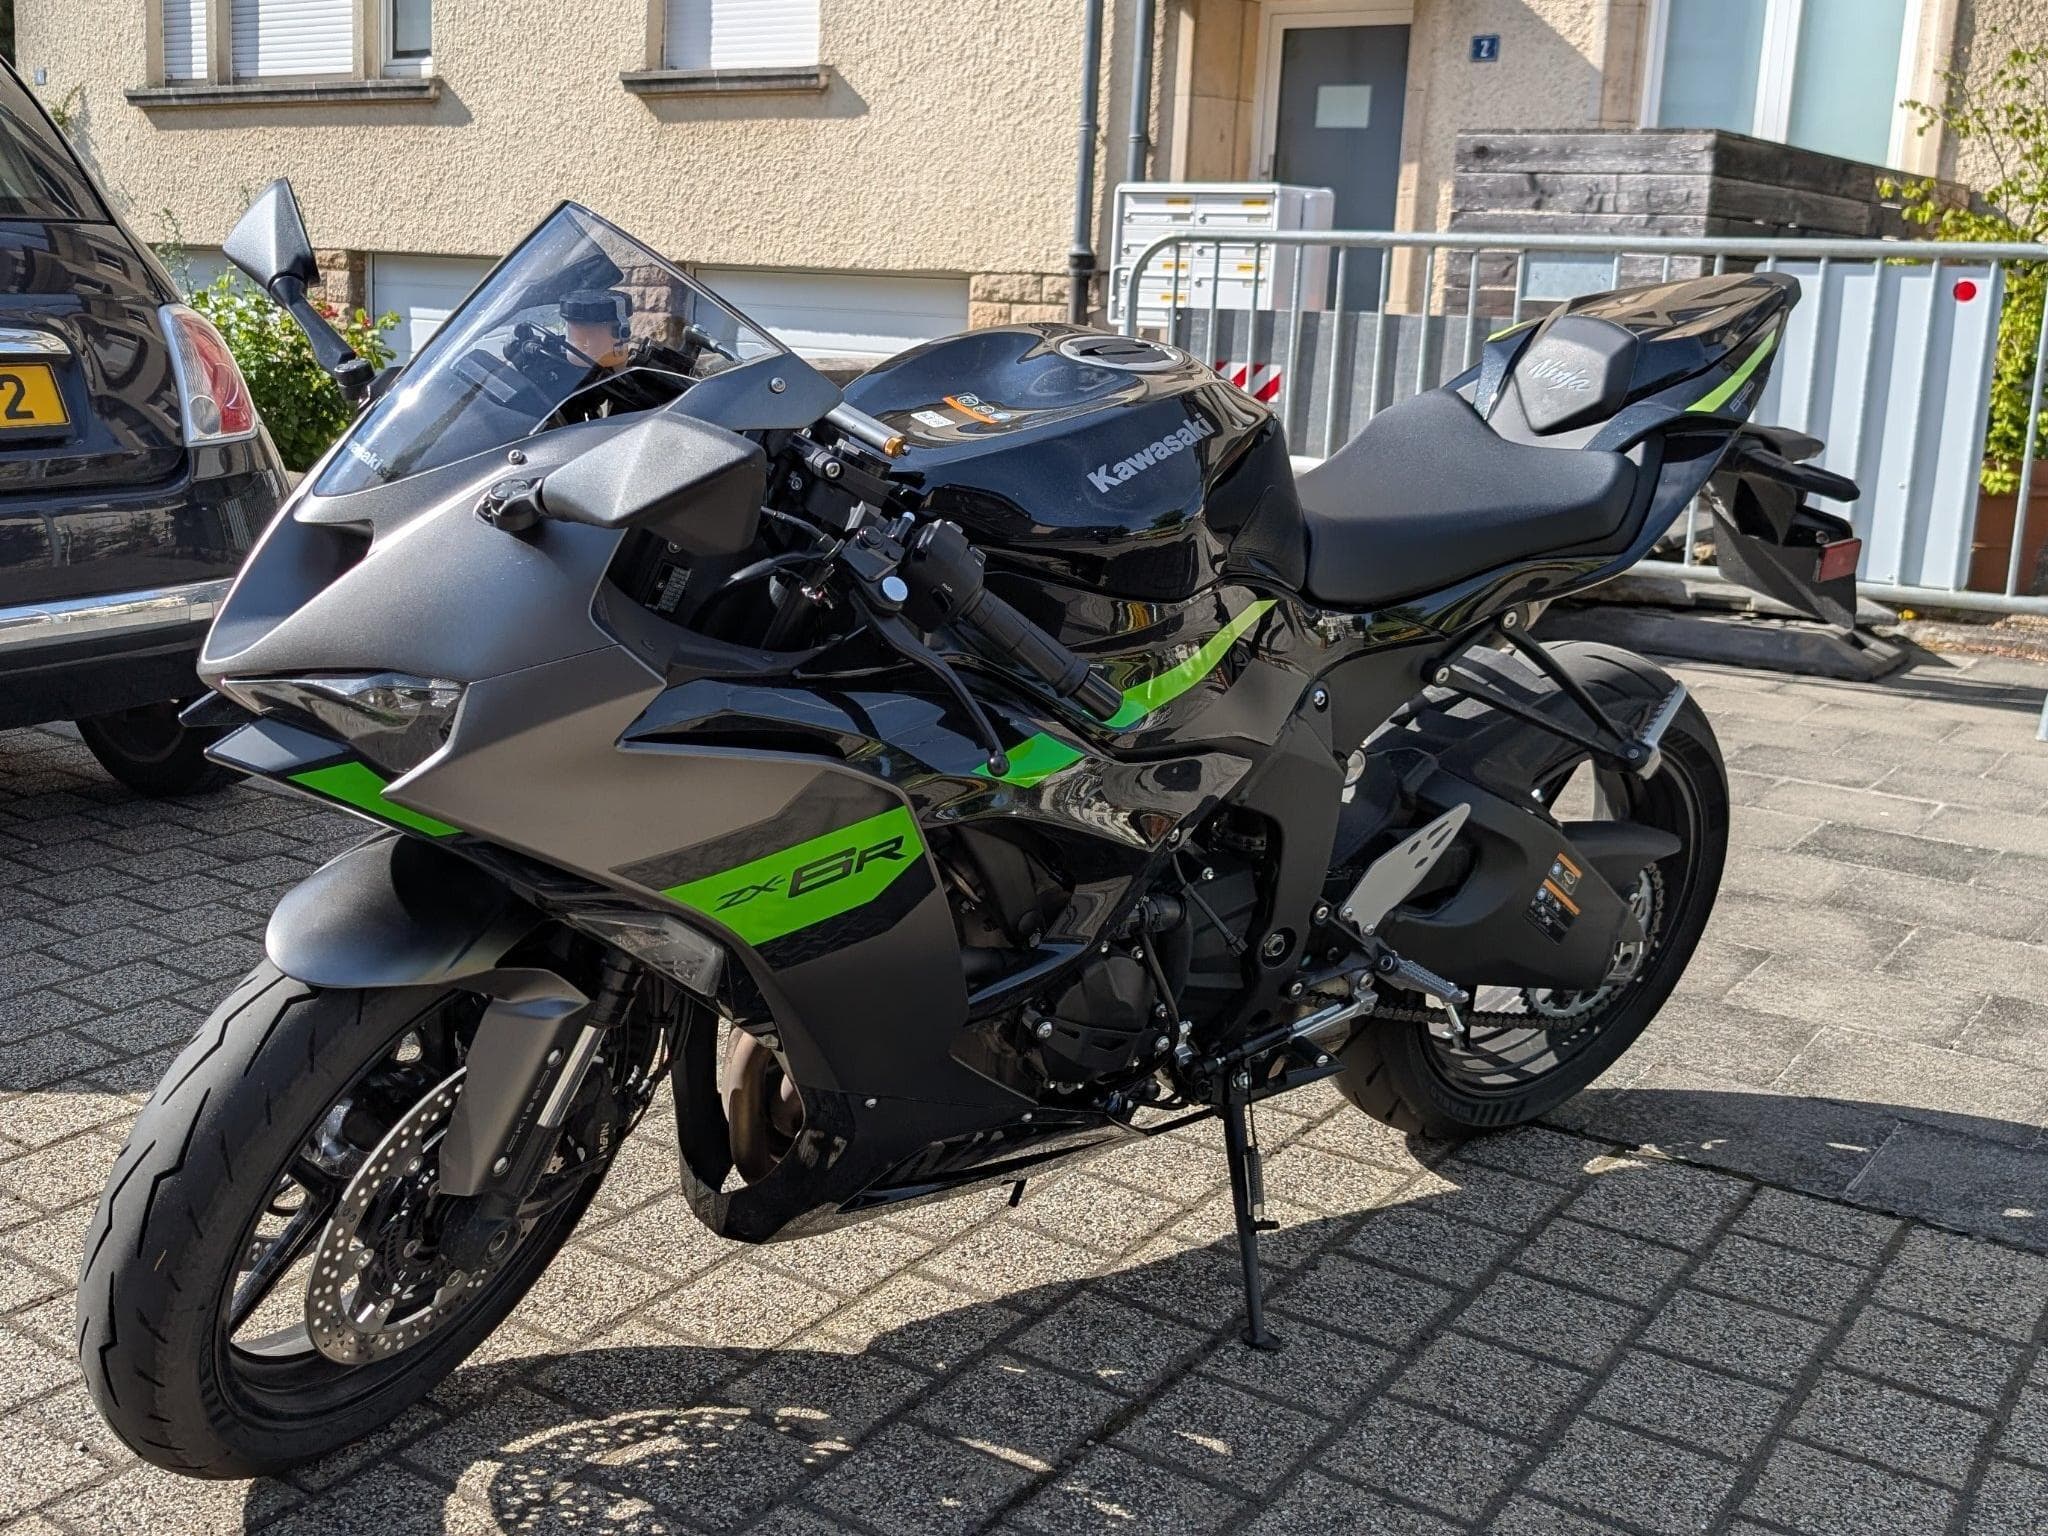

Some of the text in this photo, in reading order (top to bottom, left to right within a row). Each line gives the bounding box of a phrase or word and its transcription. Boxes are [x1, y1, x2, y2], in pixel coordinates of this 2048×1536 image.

[1480, 40, 1490, 58] 2
[1527, 359, 1592, 391] Ninja
[1086, 412, 1216, 494] Kawasaki
[713, 835, 907, 913] ZX-6R
